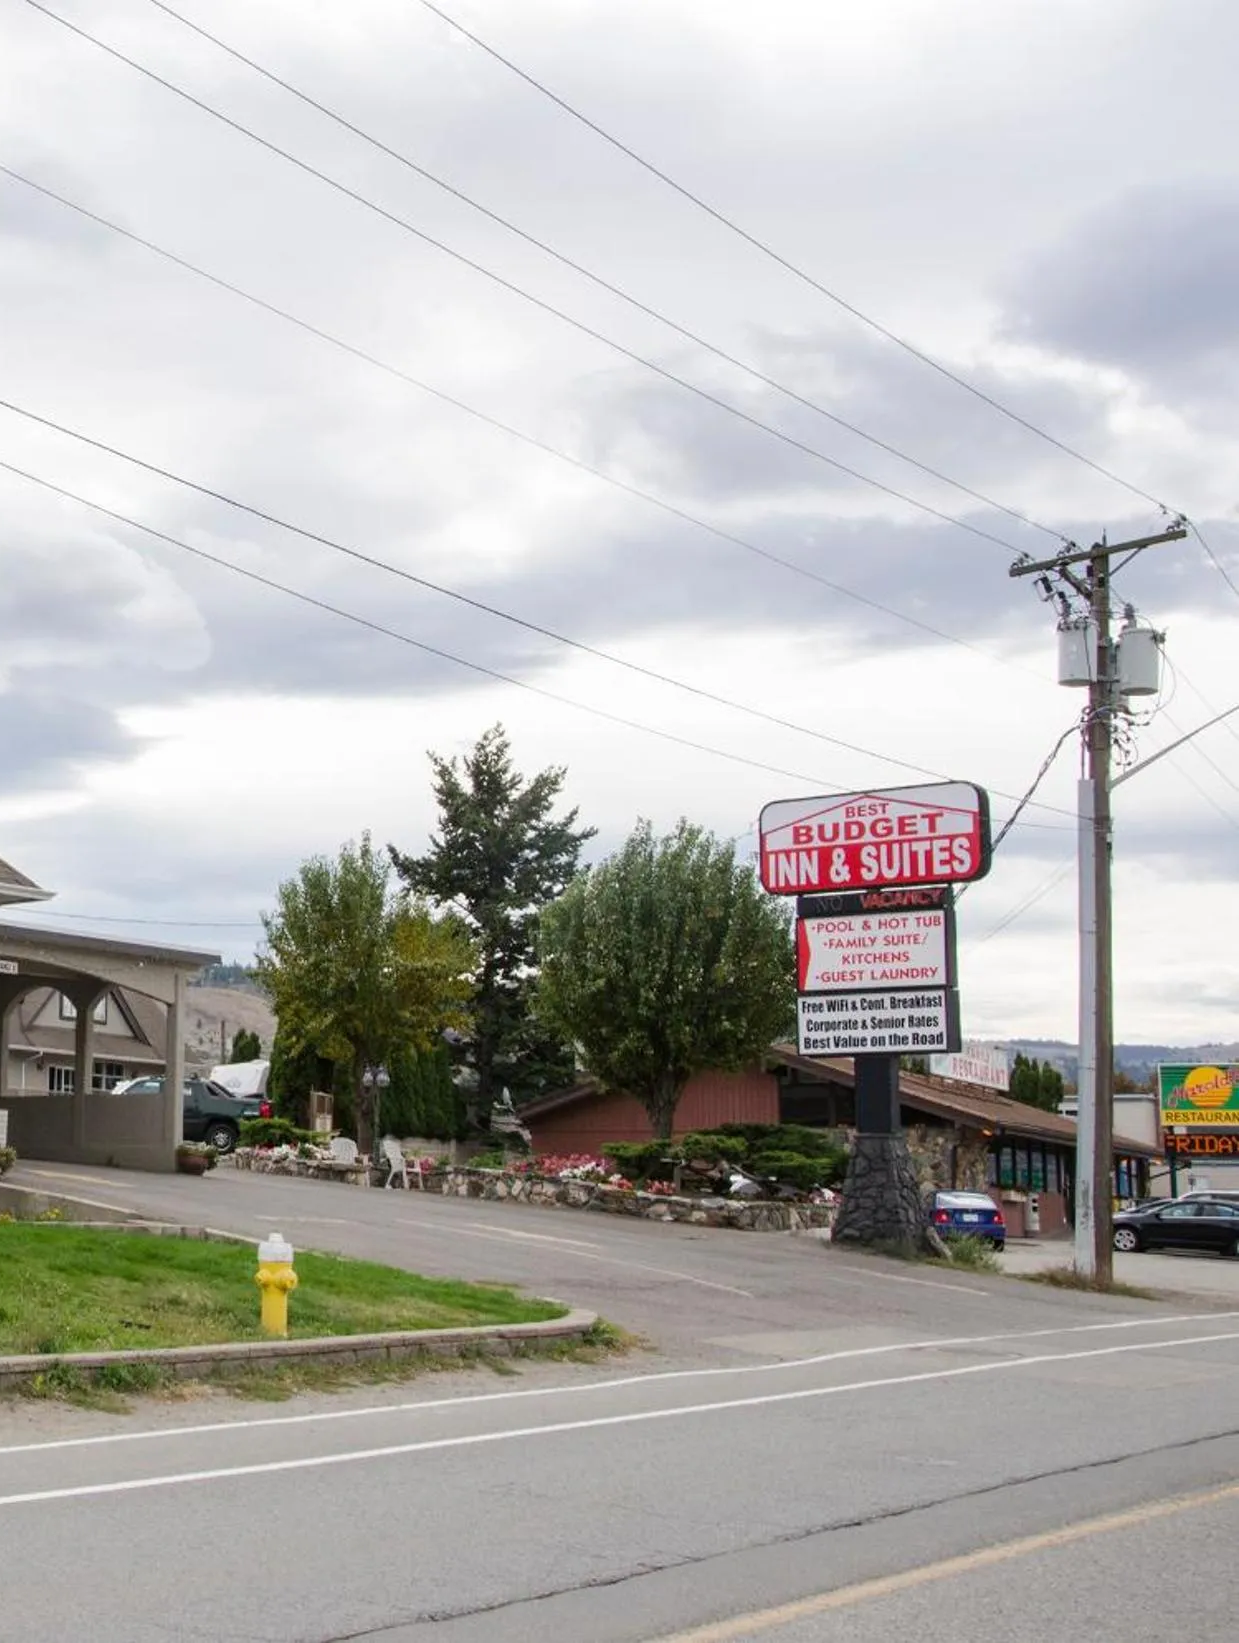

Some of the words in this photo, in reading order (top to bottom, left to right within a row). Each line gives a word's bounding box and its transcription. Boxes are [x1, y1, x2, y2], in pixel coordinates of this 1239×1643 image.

[845, 802, 889, 818] BEST
[792, 812, 944, 845] BUDGET
[768, 851, 819, 888] INN
[830, 847, 851, 883] &
[861, 837, 971, 882] SUITES
[860, 888, 943, 910] VACANCY
[817, 921, 855, 933] POOL
[862, 920, 871, 931] &
[878, 917, 908, 929] HOT
[915, 916, 941, 928] TUB
[828, 936, 877, 949] FAMILY
[841, 951, 910, 965] KITCHENS
[820, 969, 864, 983] GUEST
[871, 966, 939, 980] LAUNDRY
[802, 1001, 824, 1014] Free
[851, 1000, 858, 1012] &
[890, 994, 942, 1010] Breakfast
[806, 1018, 858, 1033] Corporate
[861, 1019, 868, 1030] &
[870, 1016, 905, 1030] Senior
[908, 1014, 939, 1028] Rates
[804, 1036, 830, 1050] Best
[833, 1034, 868, 1048] Value
[870, 1035, 886, 1047] on
[888, 1033, 909, 1046] the
[912, 1031, 944, 1045] Road
